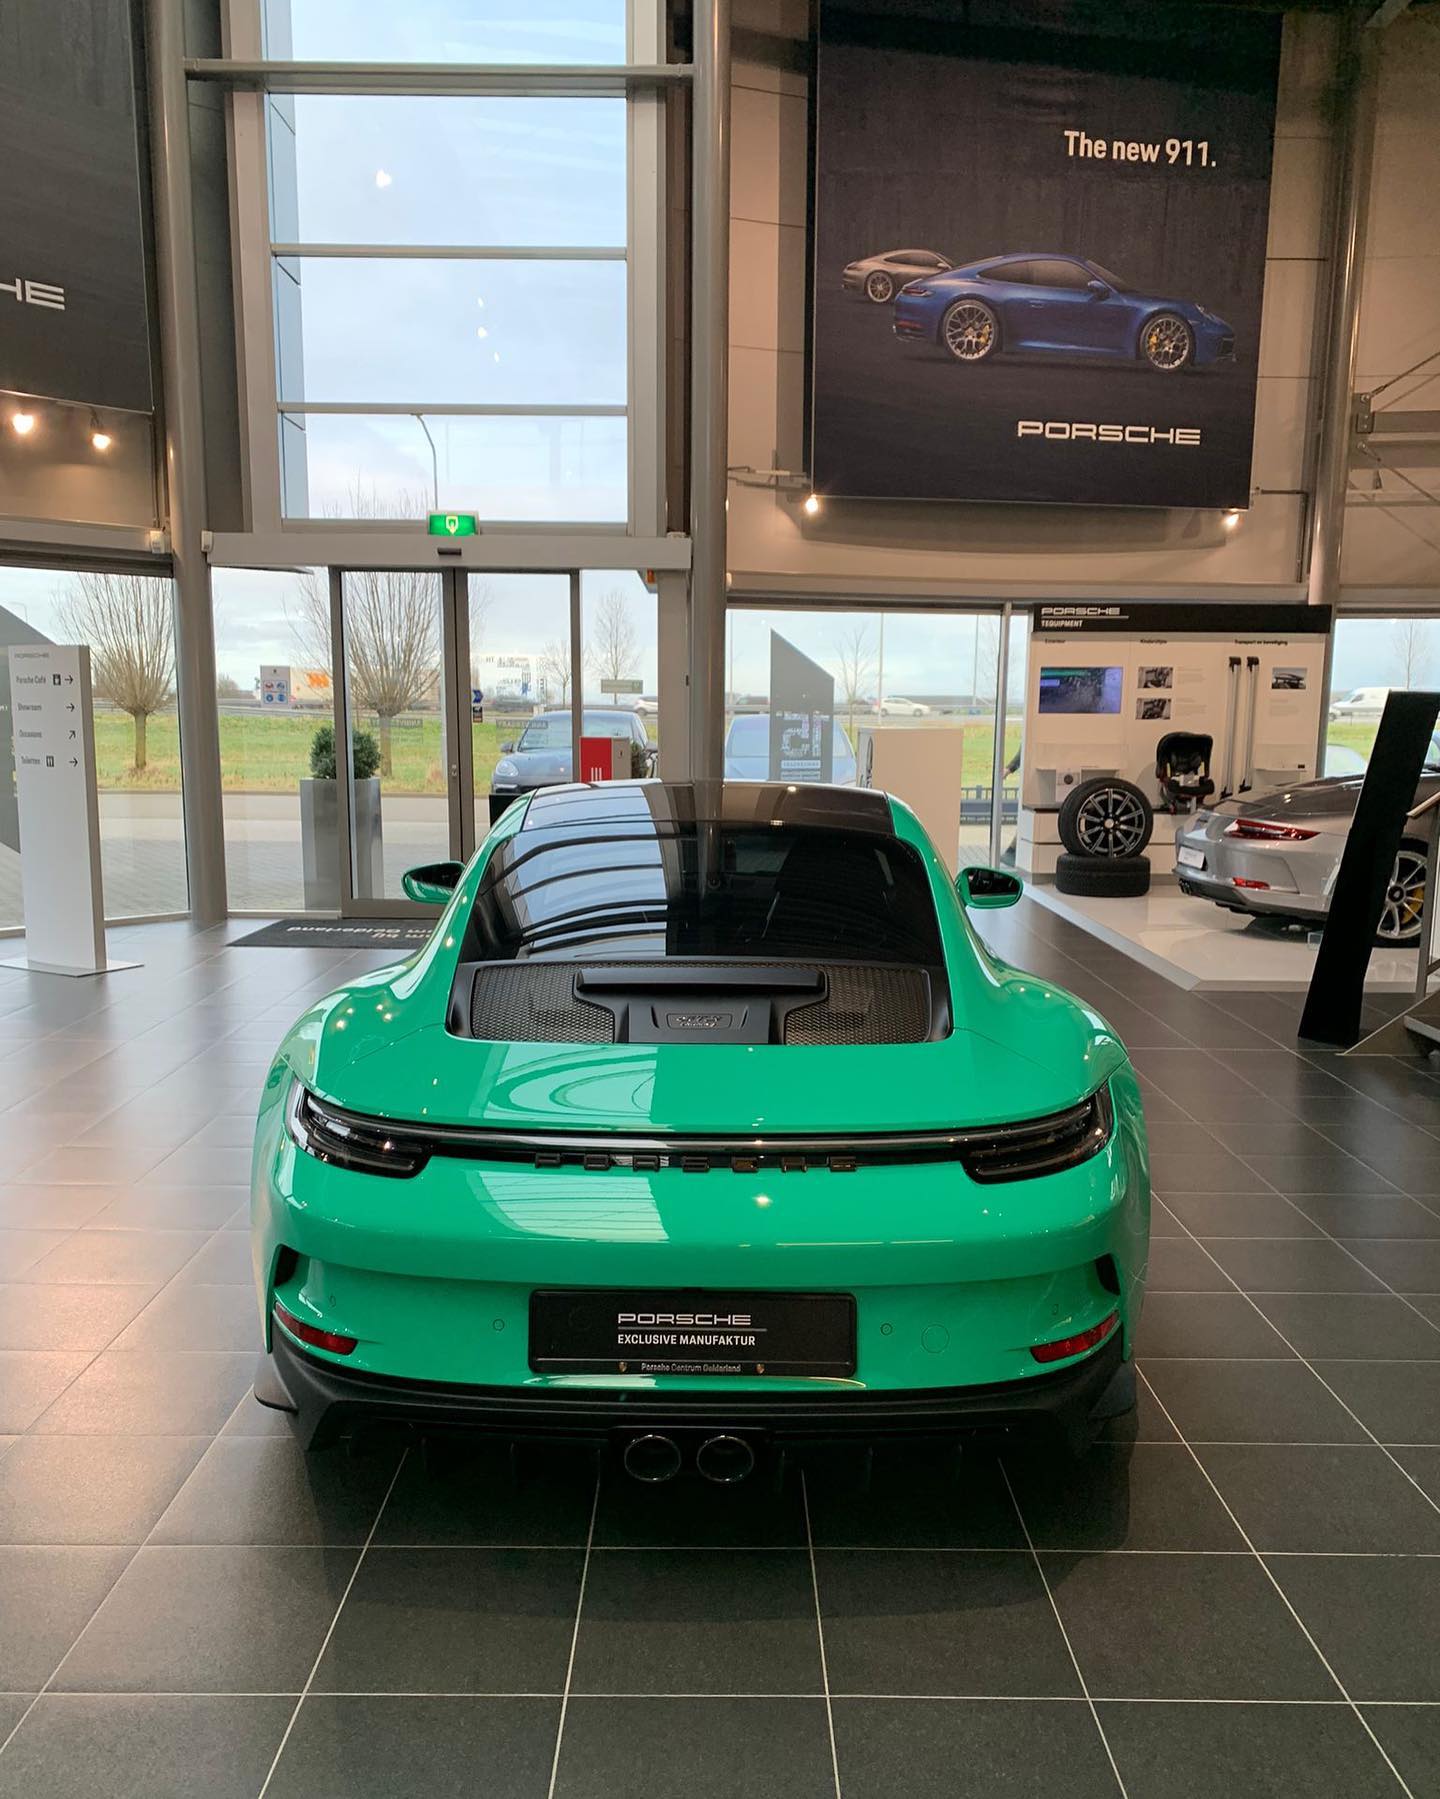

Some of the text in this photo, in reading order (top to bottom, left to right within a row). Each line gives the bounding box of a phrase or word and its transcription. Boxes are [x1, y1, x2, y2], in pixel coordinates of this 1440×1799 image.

[1064, 129, 1217, 167] The new 911.
[1017, 420, 1201, 445] PORSCHE
[1041, 606, 1121, 616] PORSCHE
[1041, 619, 1083, 628] TEQUIPMENT
[617, 1313, 752, 1326] PORSCHE
[617, 1333, 756, 1346] EXCLUSIVE MANUFAKTUR
[641, 1362, 742, 1373] Porsche Centrum Gelderland
